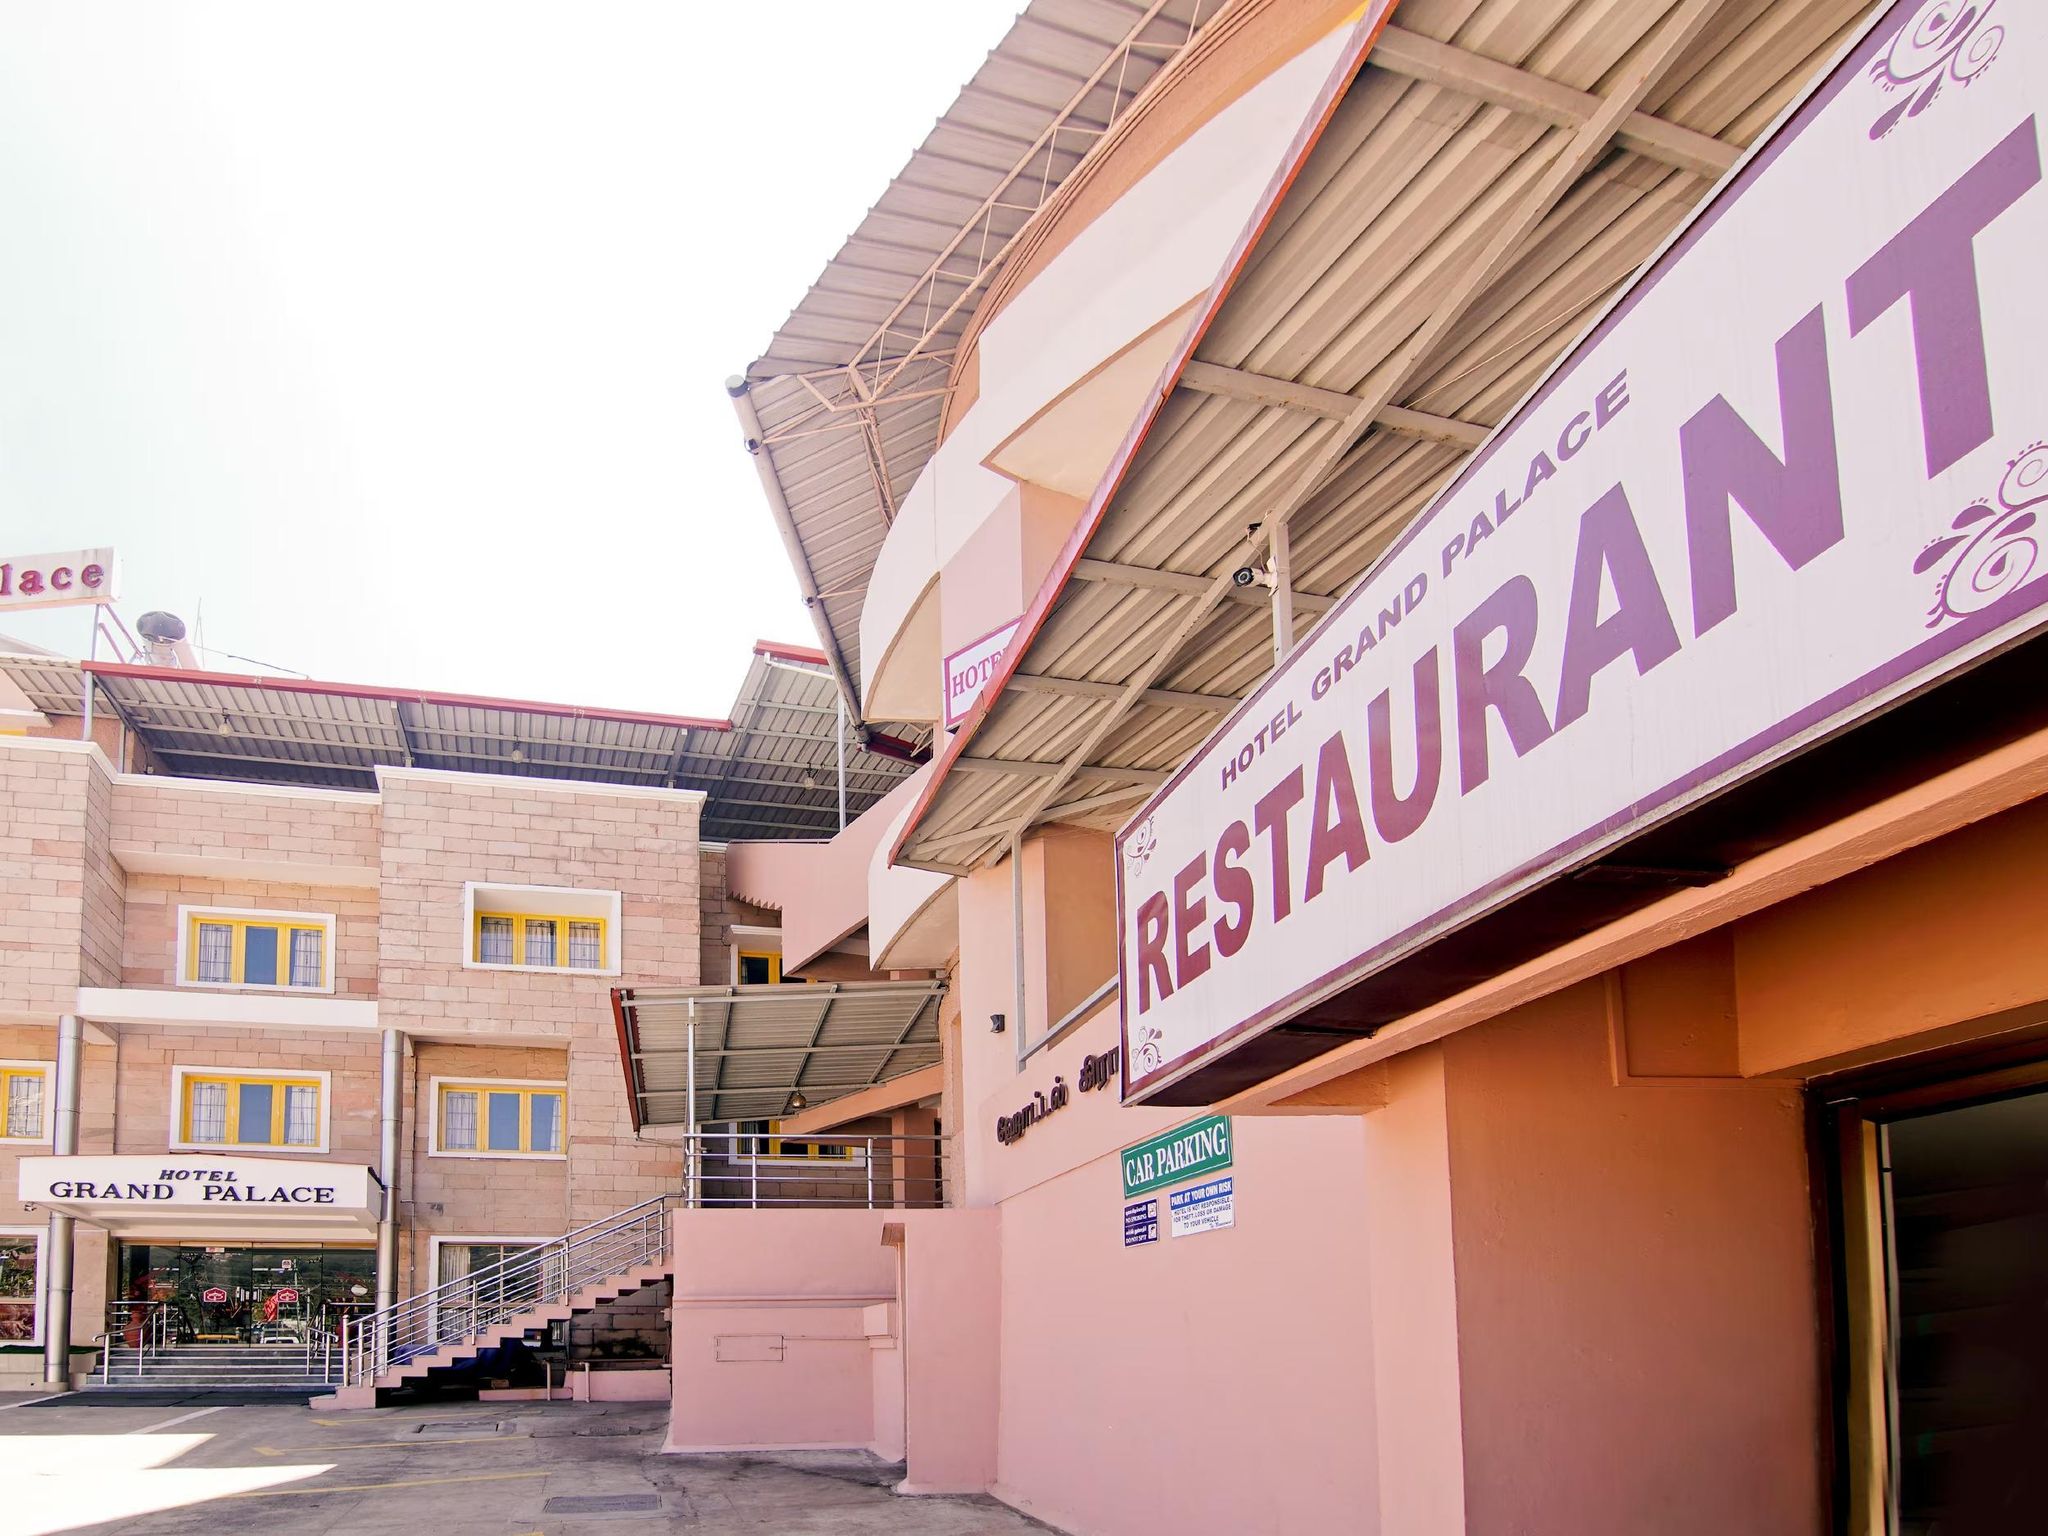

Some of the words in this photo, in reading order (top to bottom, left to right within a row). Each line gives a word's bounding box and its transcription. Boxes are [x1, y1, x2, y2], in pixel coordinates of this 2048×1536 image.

[0, 563, 104, 596] lace
[1137, 116, 2042, 1016] RESTAURANT
[1222, 700, 1303, 791] HOTEL
[1311, 572, 1428, 701] GRAND
[1442, 367, 1631, 580] PALACE
[1126, 1153, 1155, 1187] CAR
[1156, 1122, 1227, 1177] PARKING
[158, 1169, 239, 1182] HOTEL
[49, 1181, 174, 1200] GRAND
[202, 1185, 335, 1204] PALACE
[1171, 1194, 1184, 1206] PARK
[1184, 1192, 1191, 1203] AT
[1191, 1188, 1206, 1201] YOUR
[1205, 1185, 1218, 1197] OWN
[1218, 1180, 1232, 1194] RISK
